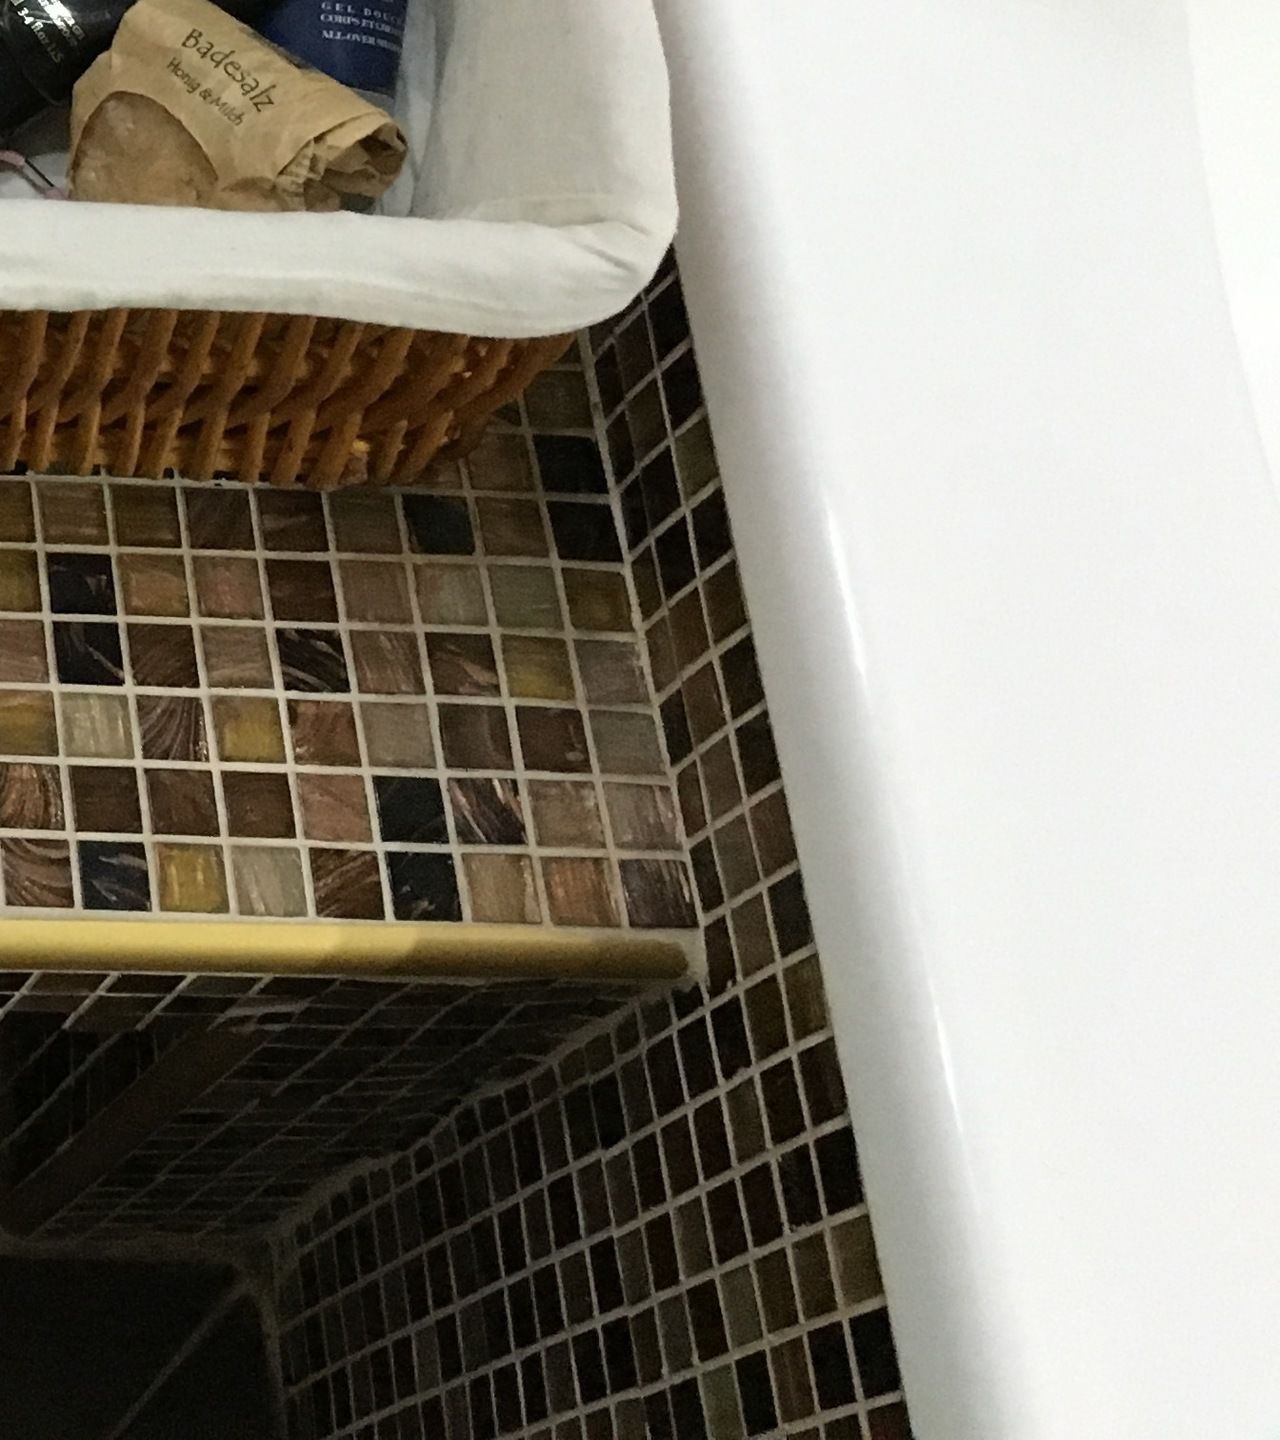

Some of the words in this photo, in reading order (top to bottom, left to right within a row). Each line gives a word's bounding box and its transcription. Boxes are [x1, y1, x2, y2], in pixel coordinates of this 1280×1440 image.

[321, 1, 356, 13] GEL
[166, 57, 201, 94] Honig
[199, 88, 212, 101] &
[209, 97, 245, 126] Milch
[181, 28, 277, 113] Badesalz
